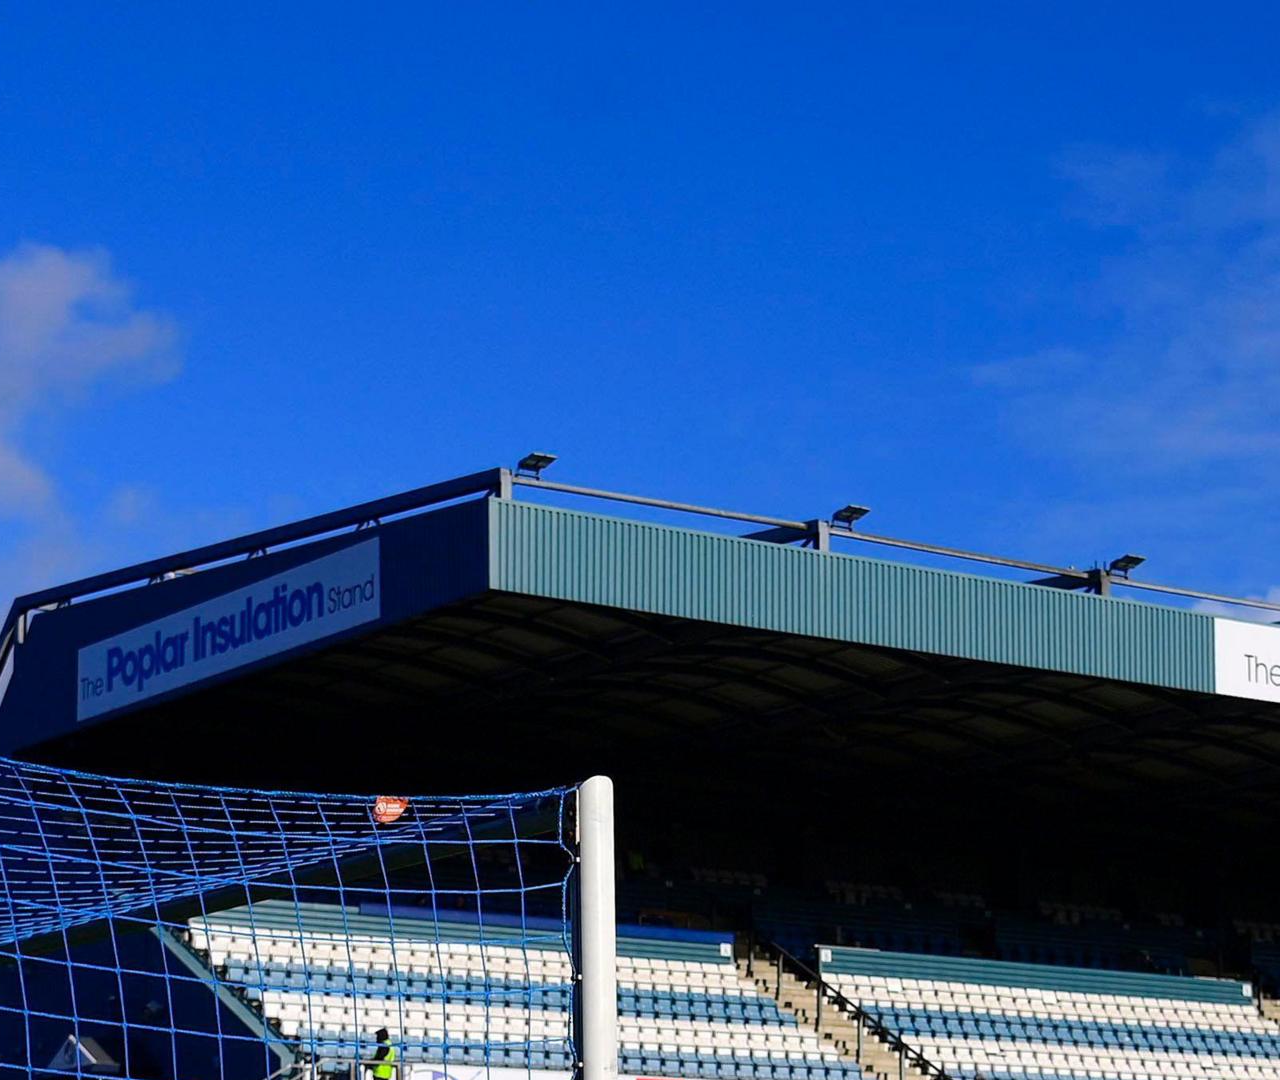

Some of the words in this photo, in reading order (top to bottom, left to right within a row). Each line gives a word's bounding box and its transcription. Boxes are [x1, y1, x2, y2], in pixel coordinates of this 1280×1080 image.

[81, 676, 104, 700] The
[106, 624, 190, 692] Poplar
[193, 581, 324, 661] Insulation
[328, 572, 375, 614] Stand
